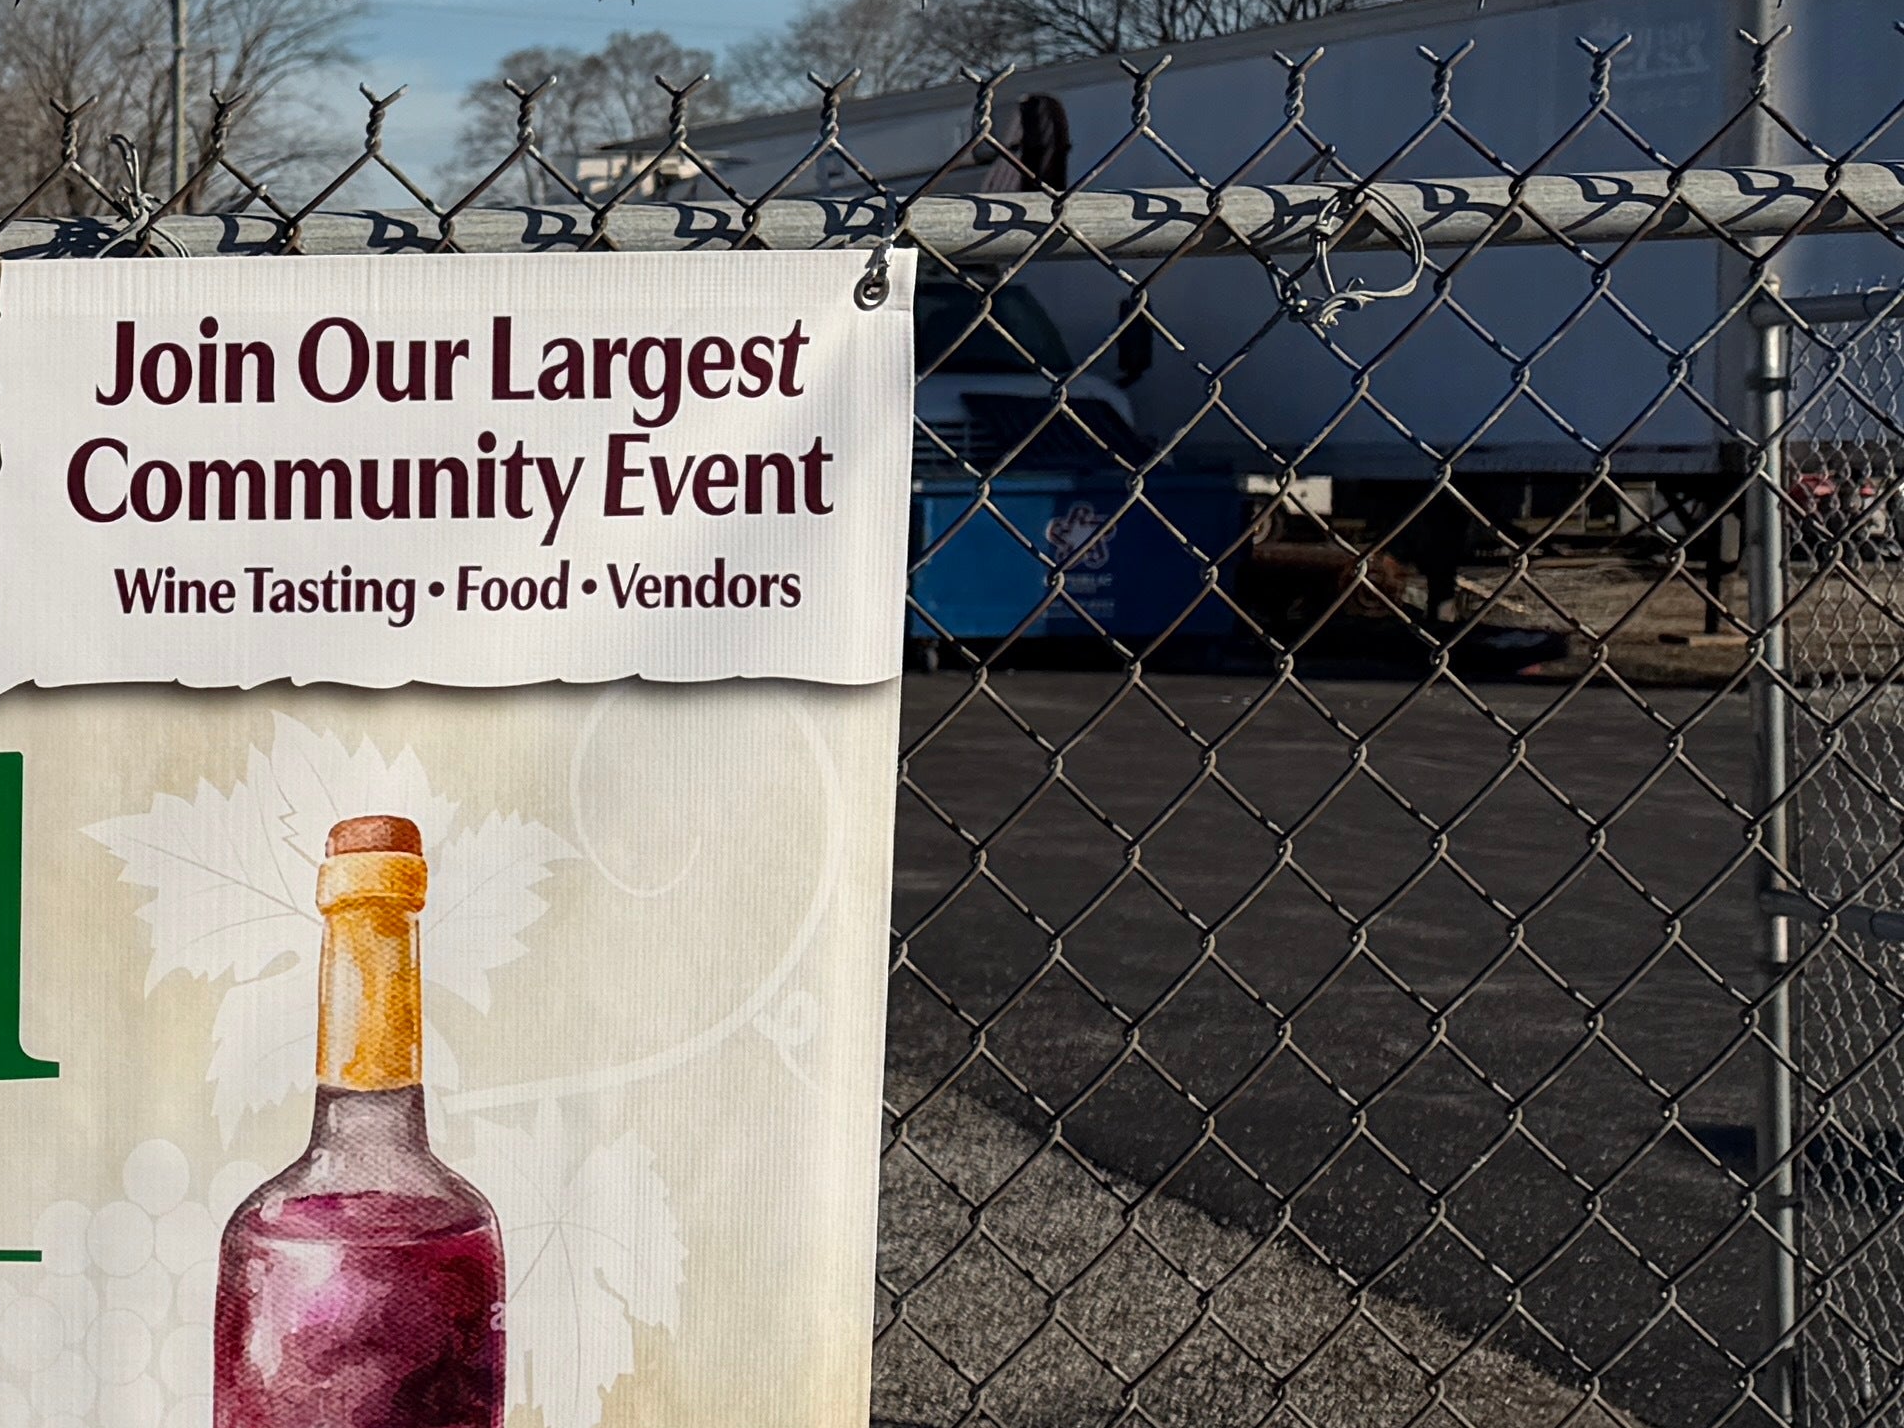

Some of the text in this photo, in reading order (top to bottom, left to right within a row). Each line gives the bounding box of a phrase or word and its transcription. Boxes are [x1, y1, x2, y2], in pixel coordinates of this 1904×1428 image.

[96, 316, 809, 425] Join Our Largest
[67, 431, 833, 546] Community Event
[115, 558, 801, 627] Wine Tasting Food Vendors
